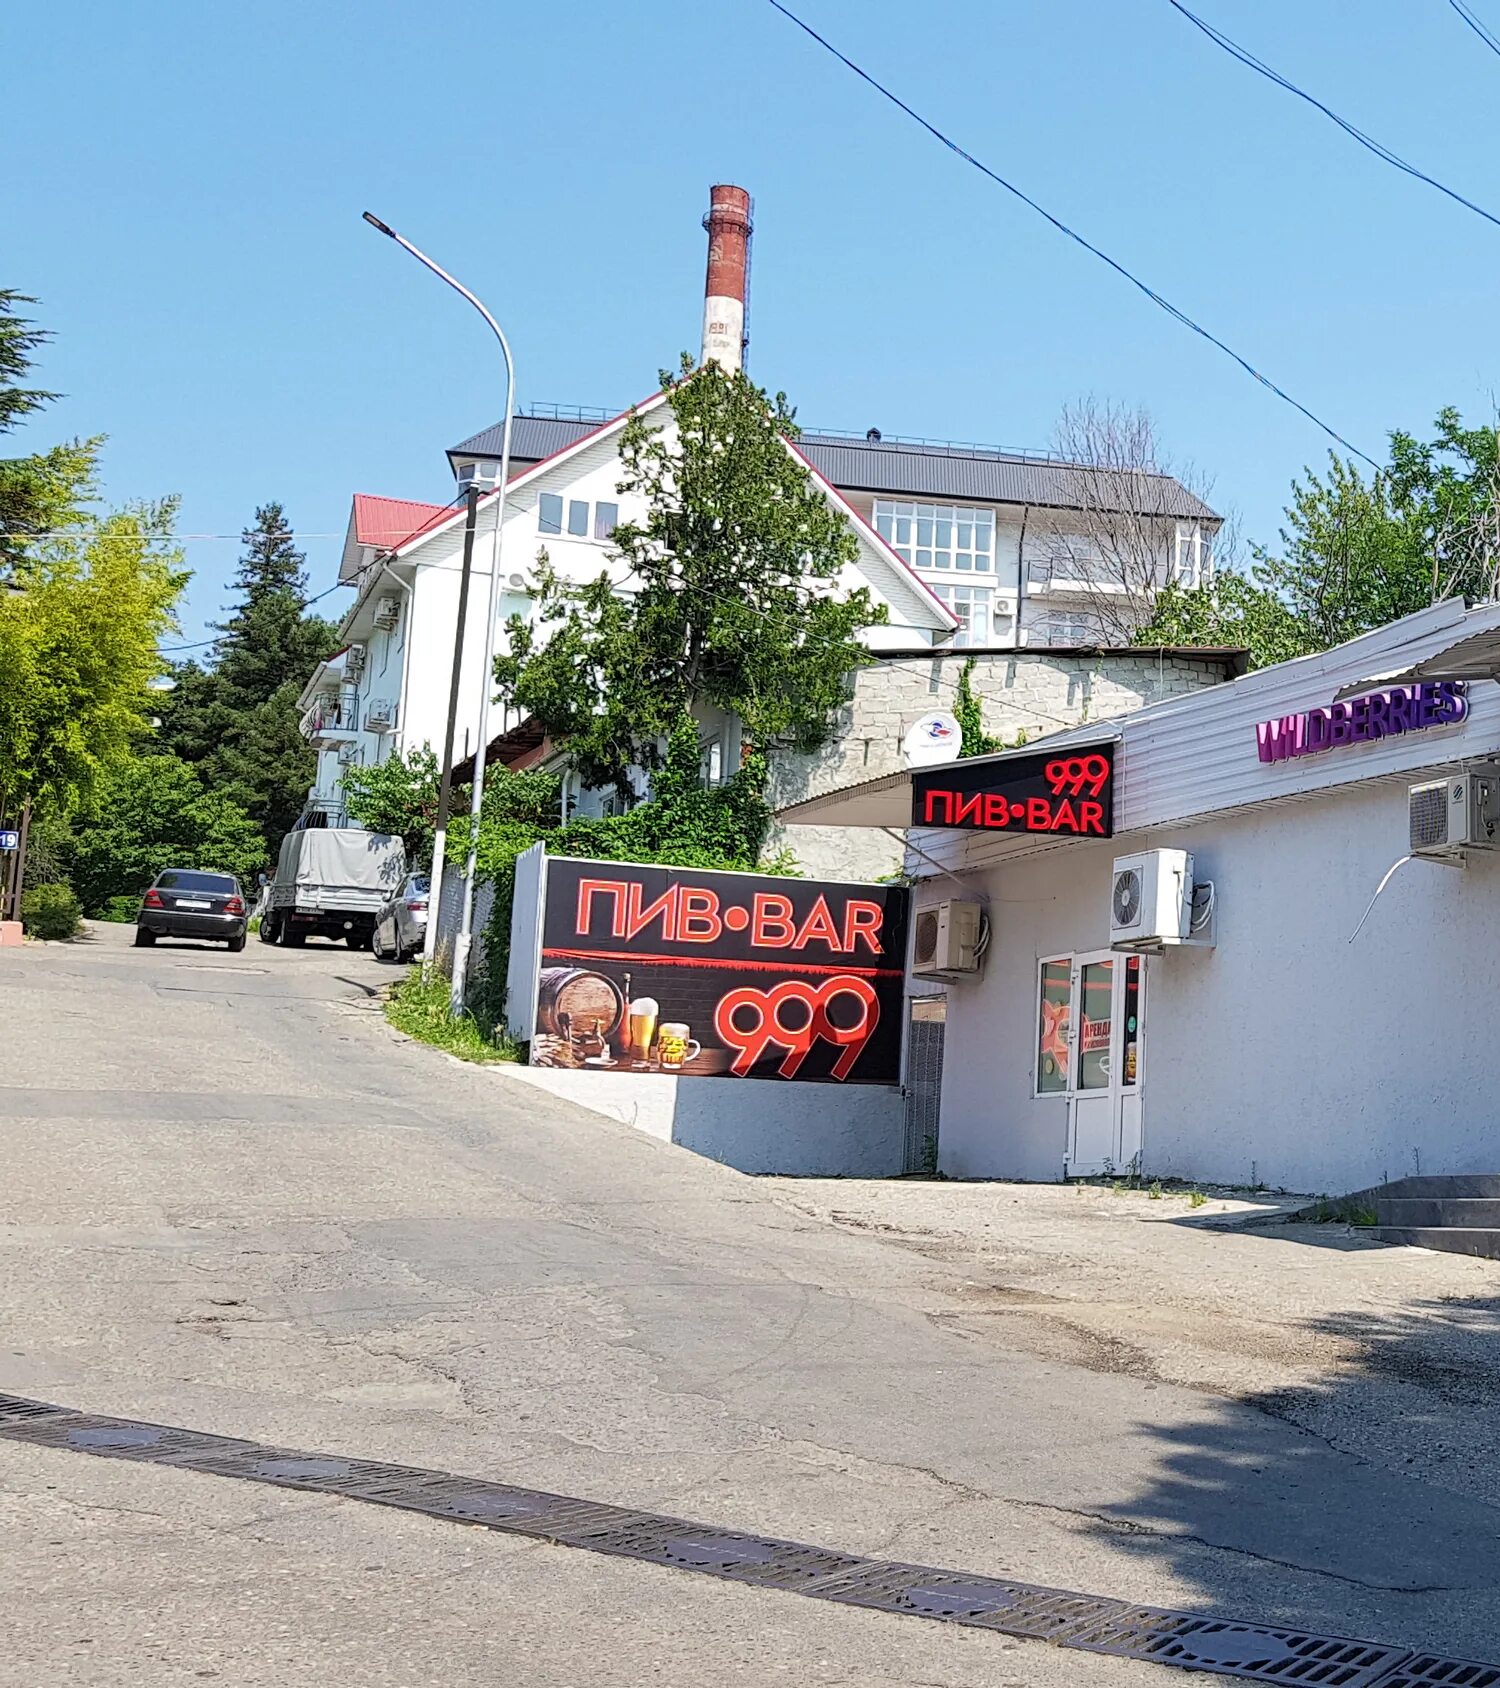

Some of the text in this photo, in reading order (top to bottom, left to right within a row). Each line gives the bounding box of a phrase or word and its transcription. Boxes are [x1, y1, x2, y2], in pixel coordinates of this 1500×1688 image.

[1256, 681, 1469, 763] WILDBERRIES
[1045, 754, 1109, 797] 999
[713, 974, 880, 1081] 999
